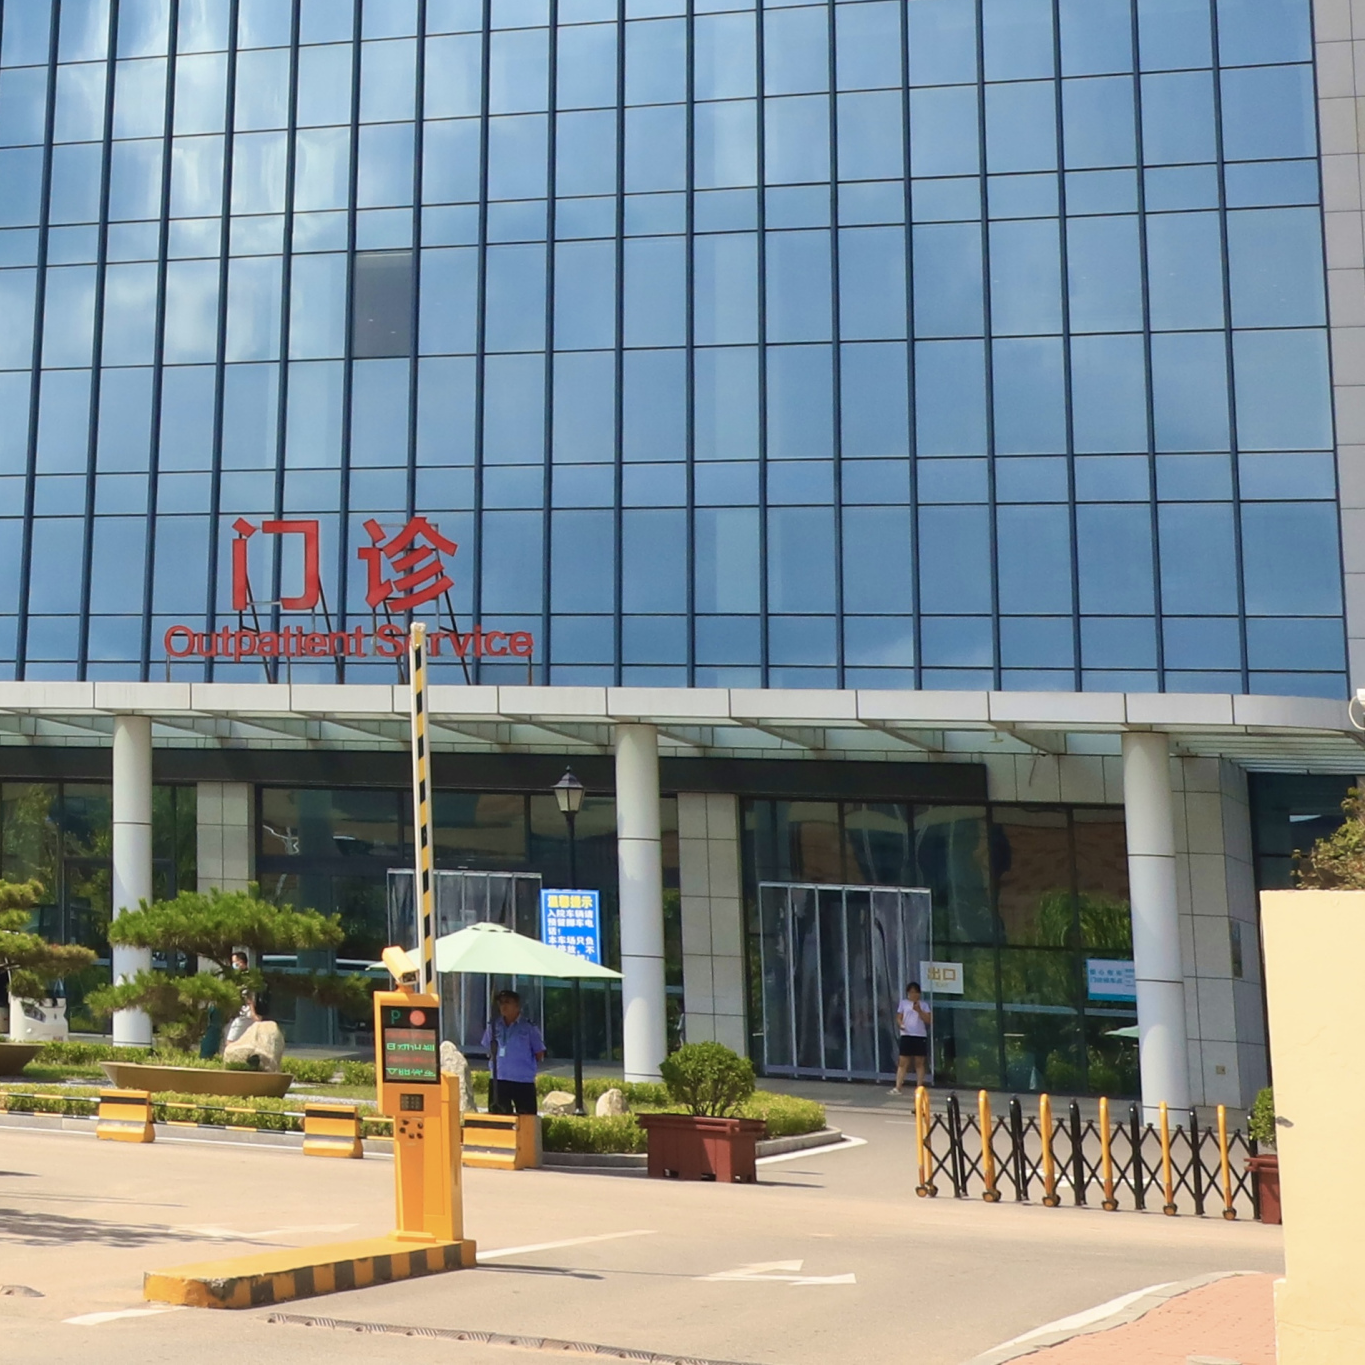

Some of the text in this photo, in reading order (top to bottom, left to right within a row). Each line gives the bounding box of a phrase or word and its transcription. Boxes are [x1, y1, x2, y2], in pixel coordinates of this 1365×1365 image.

[232, 517, 457, 611] 门诊
[164, 625, 533, 661] Outpatient Srvice
[927, 967, 956, 981] 出口
[390, 1009, 401, 1025] P
